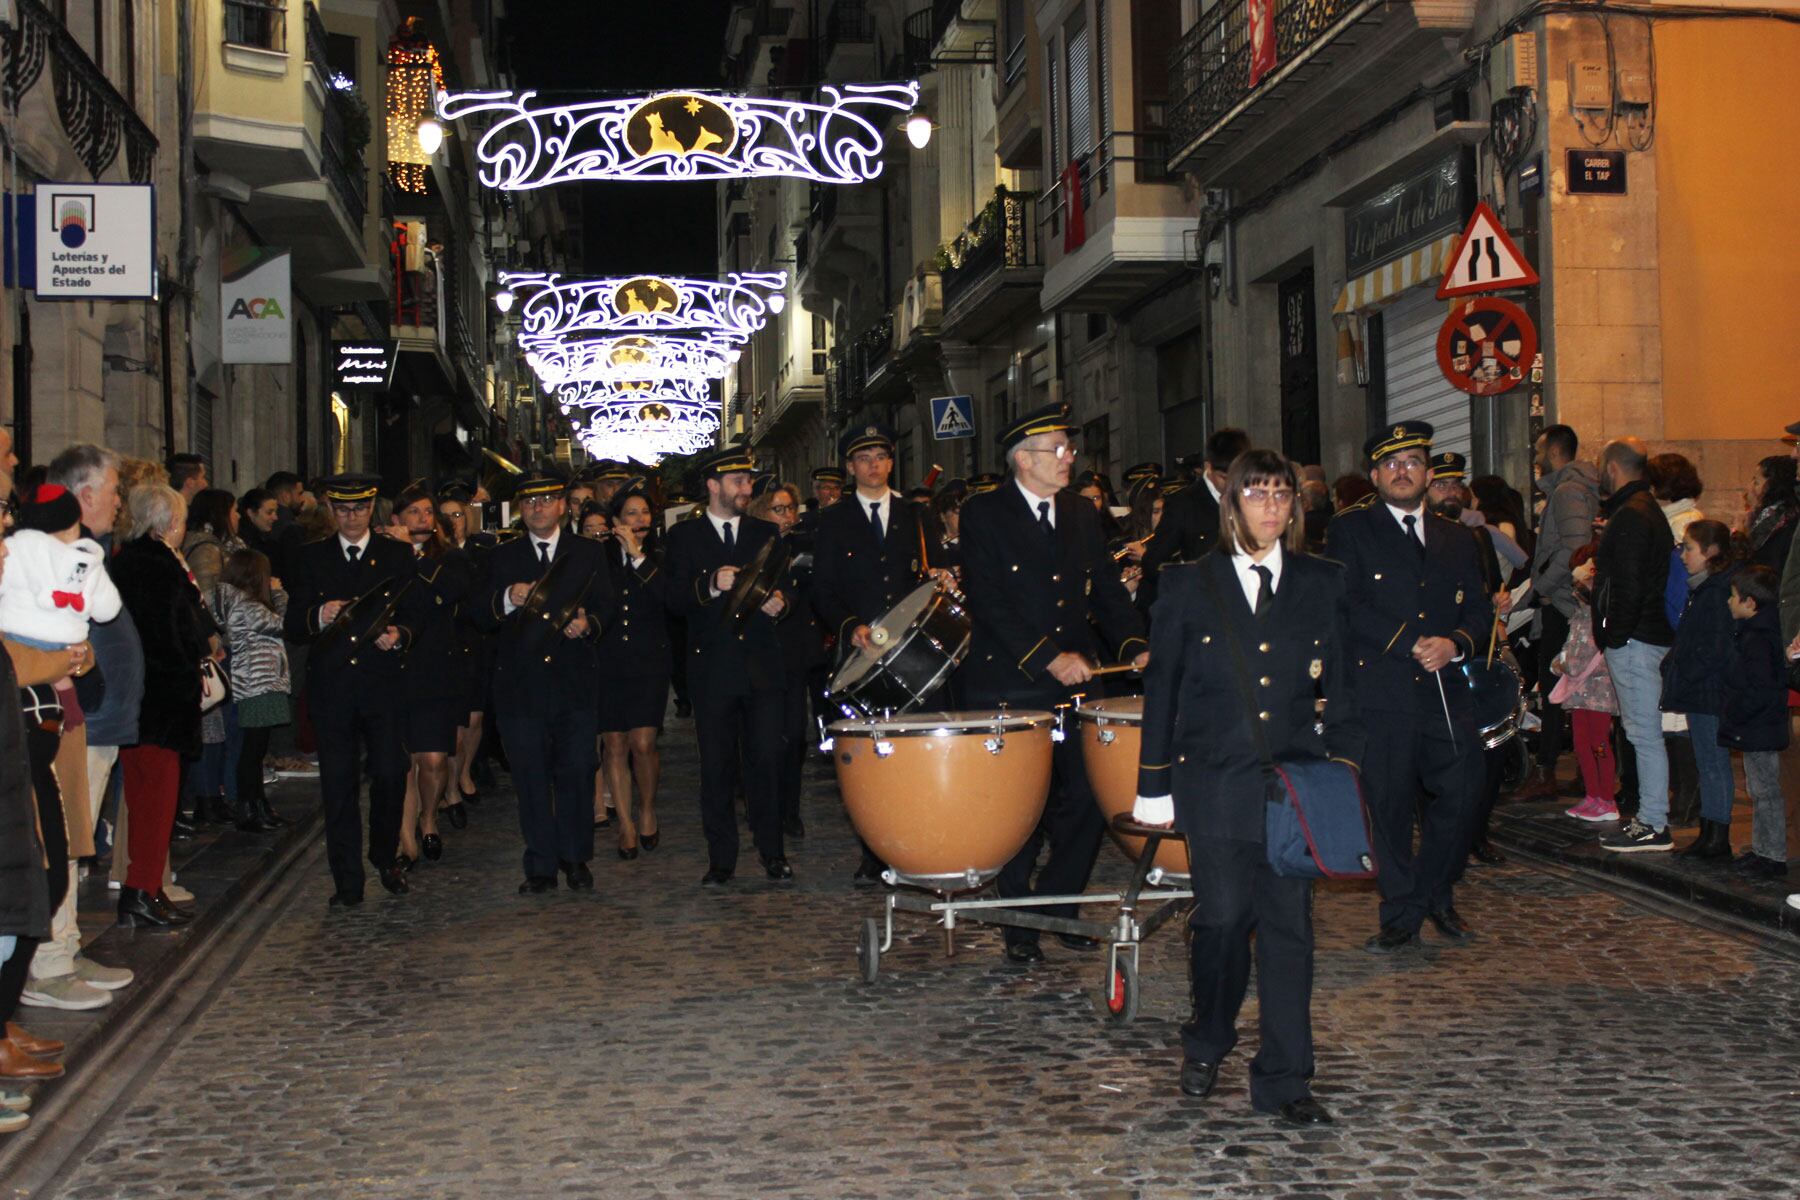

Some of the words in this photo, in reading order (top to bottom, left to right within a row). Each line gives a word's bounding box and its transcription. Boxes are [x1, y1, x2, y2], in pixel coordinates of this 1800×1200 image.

[1584, 158, 1610, 168] CARRER
[1584, 170, 1593, 180] EL
[1596, 170, 1610, 180] TAP
[1412, 190, 1426, 229] de
[52, 252, 98, 262] Loterías
[101, 254, 109, 264] y
[53, 265, 105, 276] Apuestas
[109, 265, 126, 274] del
[52, 278, 91, 287] Estado
[227, 298, 285, 319] ACA
